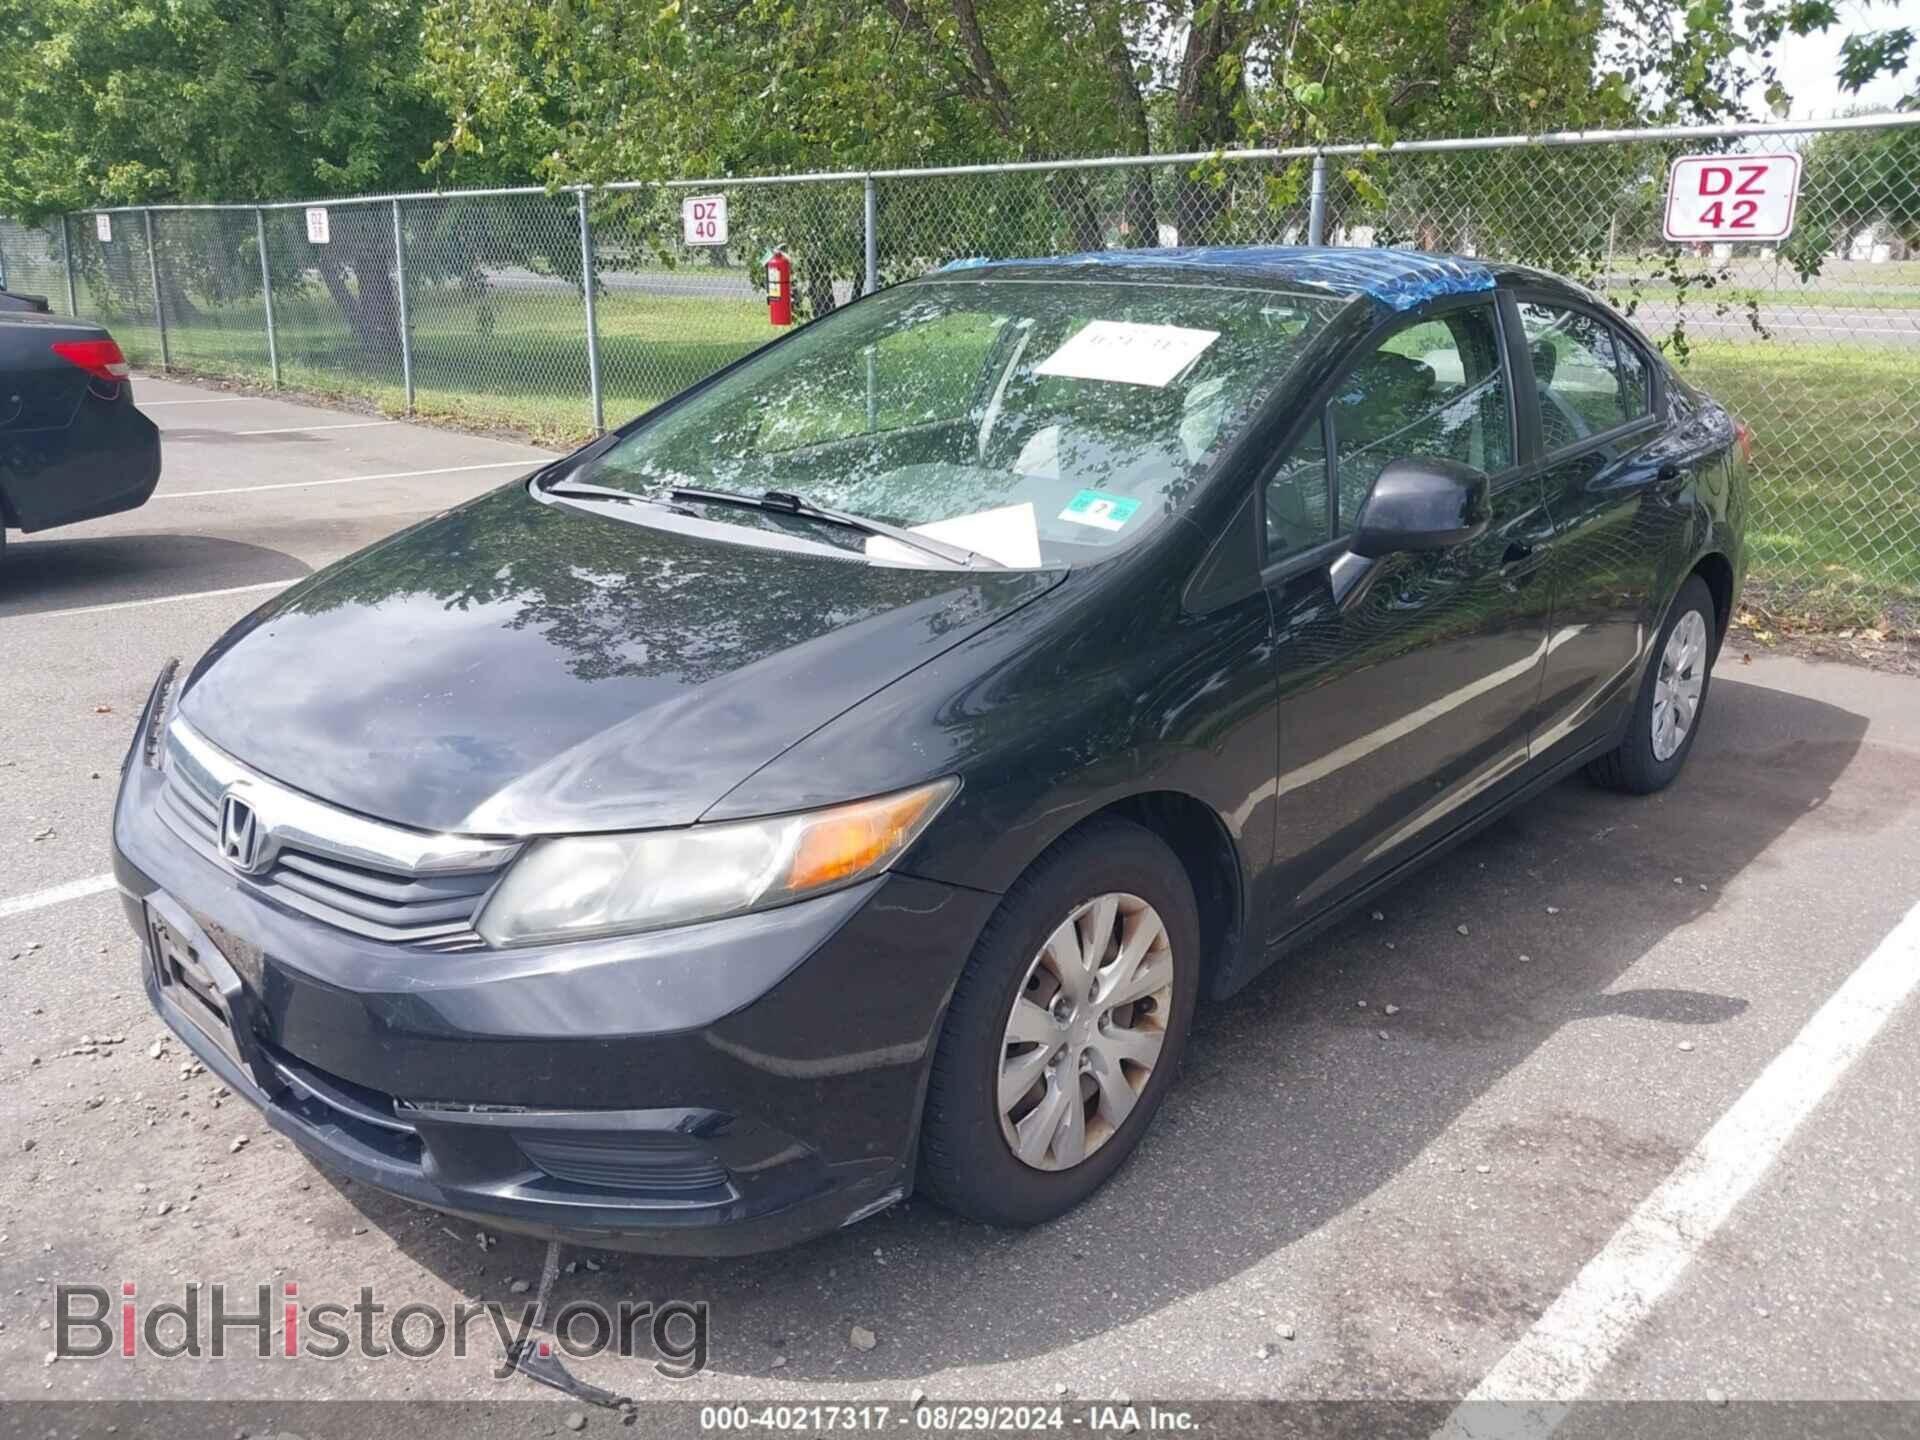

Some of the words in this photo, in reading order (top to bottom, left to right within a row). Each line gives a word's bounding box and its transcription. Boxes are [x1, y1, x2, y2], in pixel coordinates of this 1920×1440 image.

[1698, 165, 1769, 196] DZ
[694, 202, 717, 220] DZ
[1698, 200, 1758, 228] 42
[695, 221, 716, 237] 40
